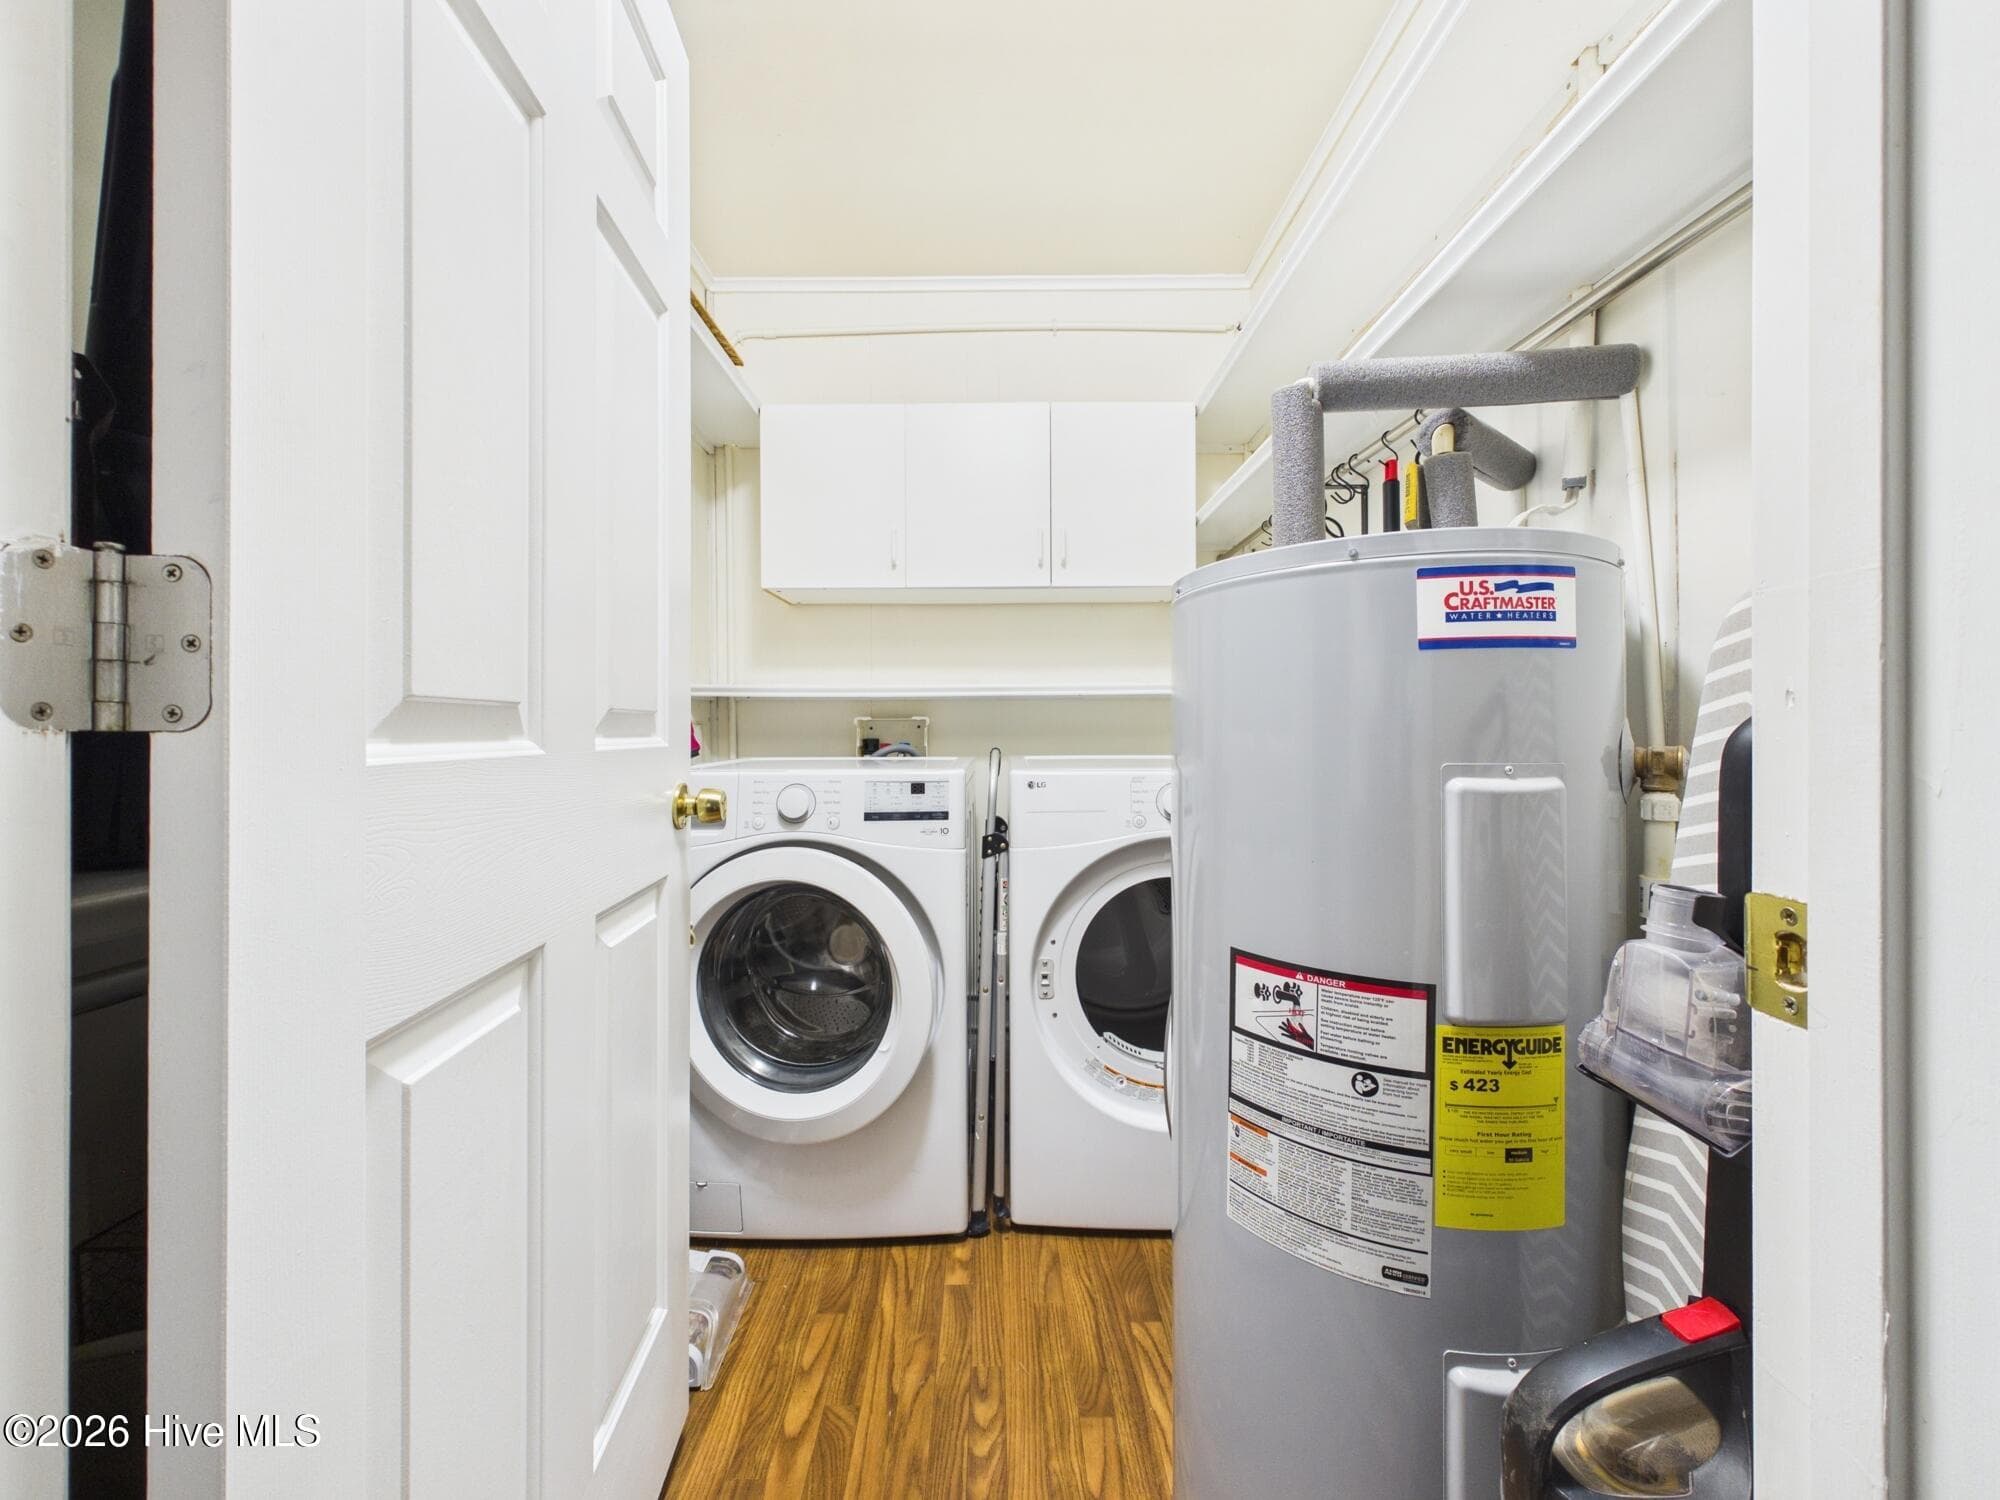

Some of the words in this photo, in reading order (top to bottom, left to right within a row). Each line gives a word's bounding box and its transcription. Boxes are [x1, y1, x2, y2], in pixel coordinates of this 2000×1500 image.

[1459, 580, 1494, 596] U.S.
[1444, 592, 1556, 610] CRAFTMASTER
[1450, 612, 1491, 620] WATER
[1307, 975, 1345, 988] DANGER
[1442, 1036, 1561, 1057] ENERGYGUIDE
[1463, 1078, 1500, 1092] 423
[1281, 1116, 1317, 1134] IMPORTANT
